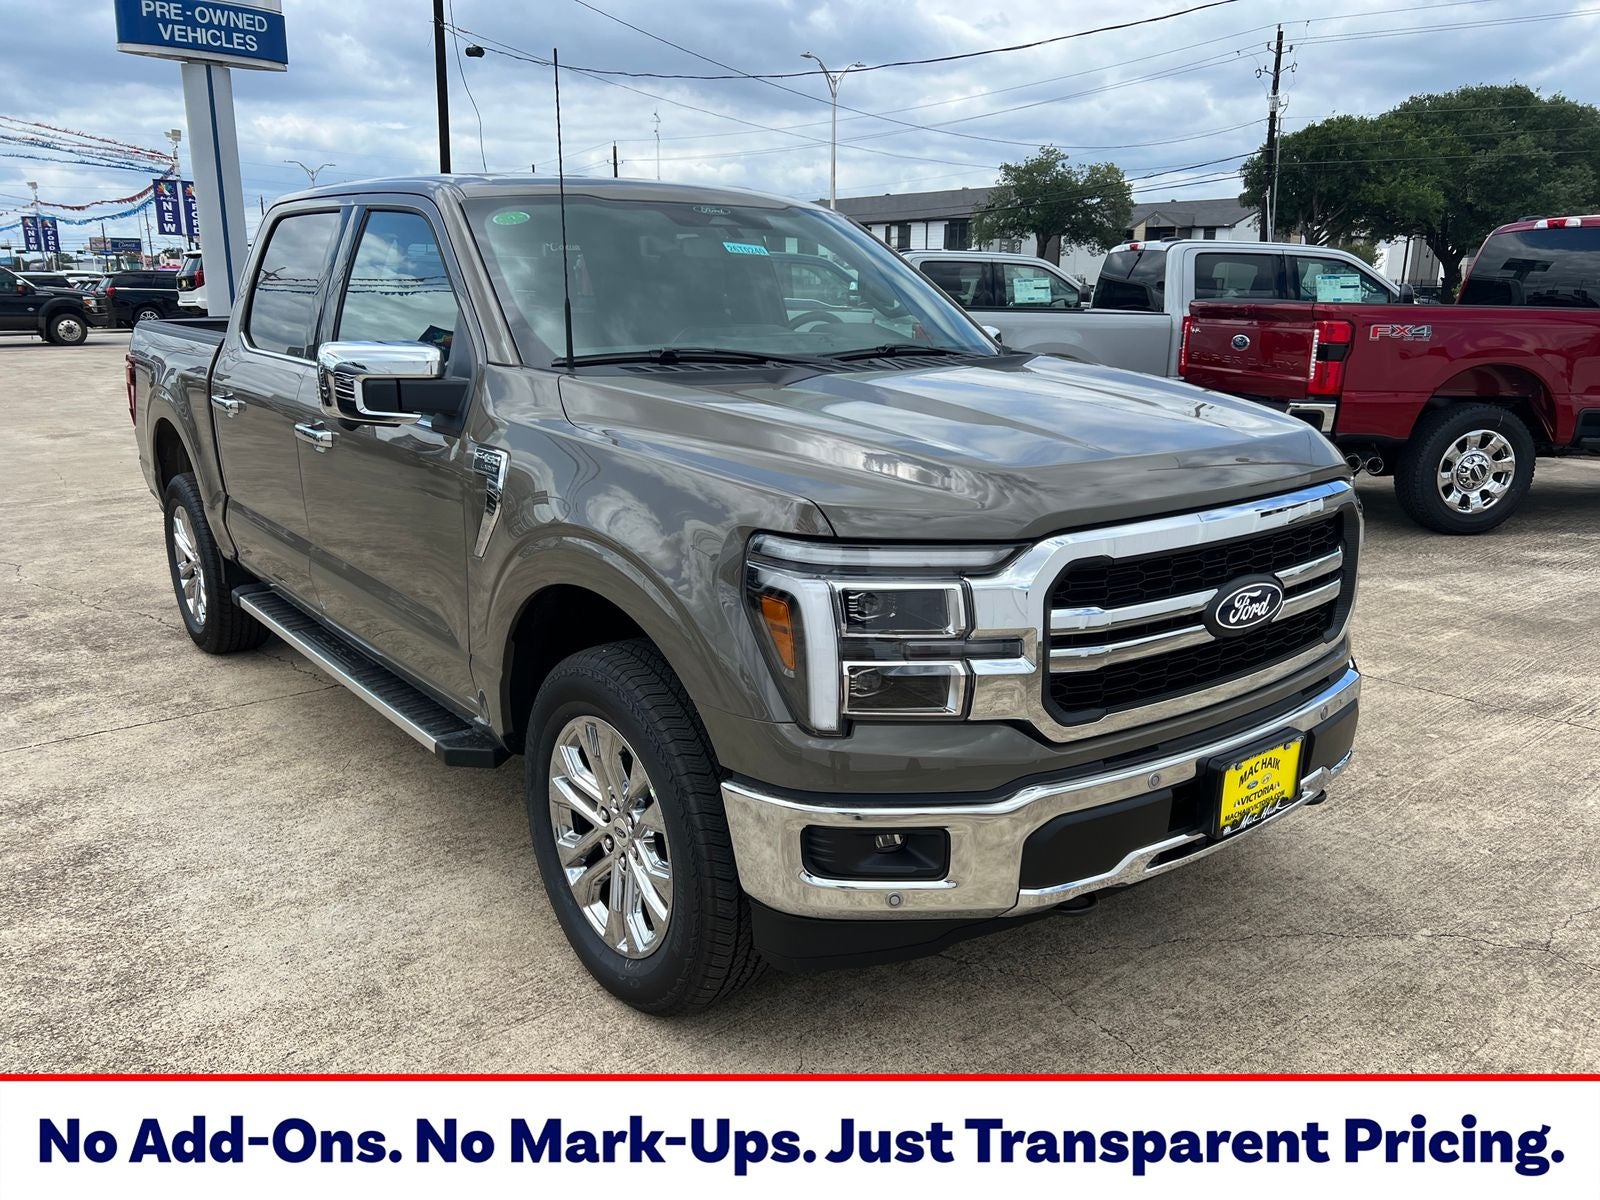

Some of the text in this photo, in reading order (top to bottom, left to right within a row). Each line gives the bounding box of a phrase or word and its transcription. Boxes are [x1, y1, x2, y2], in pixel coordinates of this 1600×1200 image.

[157, 22, 258, 52] VEHICLES
[162, 201, 177, 233] NEW
[27, 230, 38, 250] NEW
[47, 230, 56, 251] FORD
[1369, 324, 1432, 340] FX4
[1191, 351, 1243, 364] SUPER
[1229, 589, 1271, 623] Ford
[1238, 761, 1260, 788] MAC
[1260, 756, 1280, 771] HAIK
[1240, 783, 1275, 806] VICTORIA
